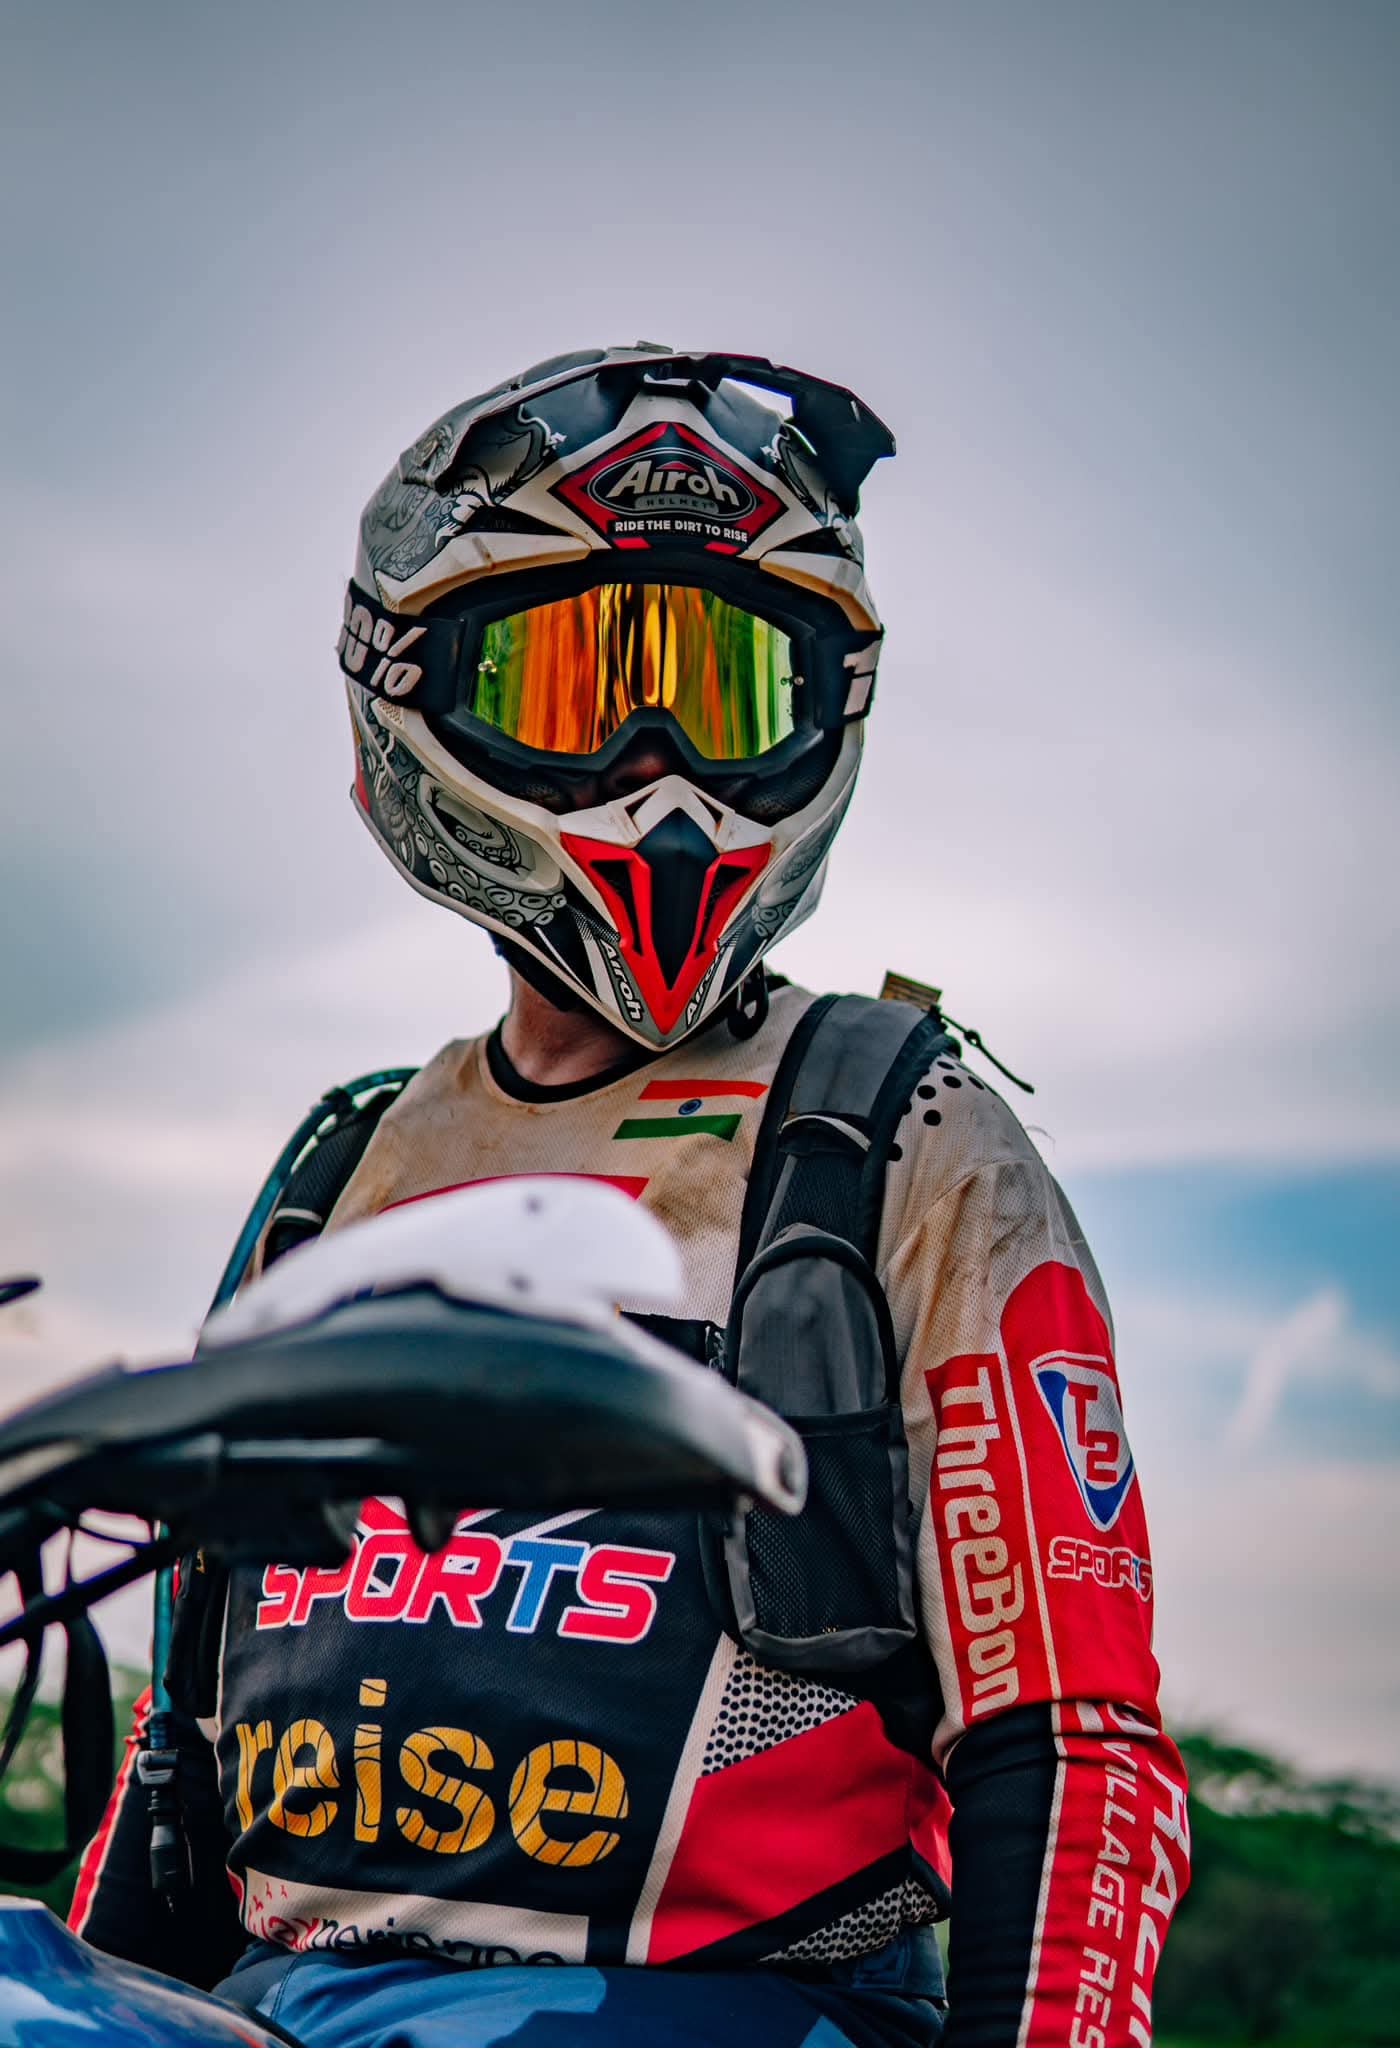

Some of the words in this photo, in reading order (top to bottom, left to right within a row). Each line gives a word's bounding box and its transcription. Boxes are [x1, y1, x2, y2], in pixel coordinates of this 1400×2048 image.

[606, 460, 740, 507] Airoh
[615, 520, 645, 532] RIDE
[646, 519, 671, 531] THE
[674, 520, 702, 532] DIRT
[704, 523, 721, 536] TO
[723, 527, 748, 542] RISE
[600, 940, 643, 1021] Airoh
[256, 1530, 676, 1645] SPORTS
[235, 1678, 629, 1867] reise
[1087, 1742, 1138, 1940] VILLAGE
